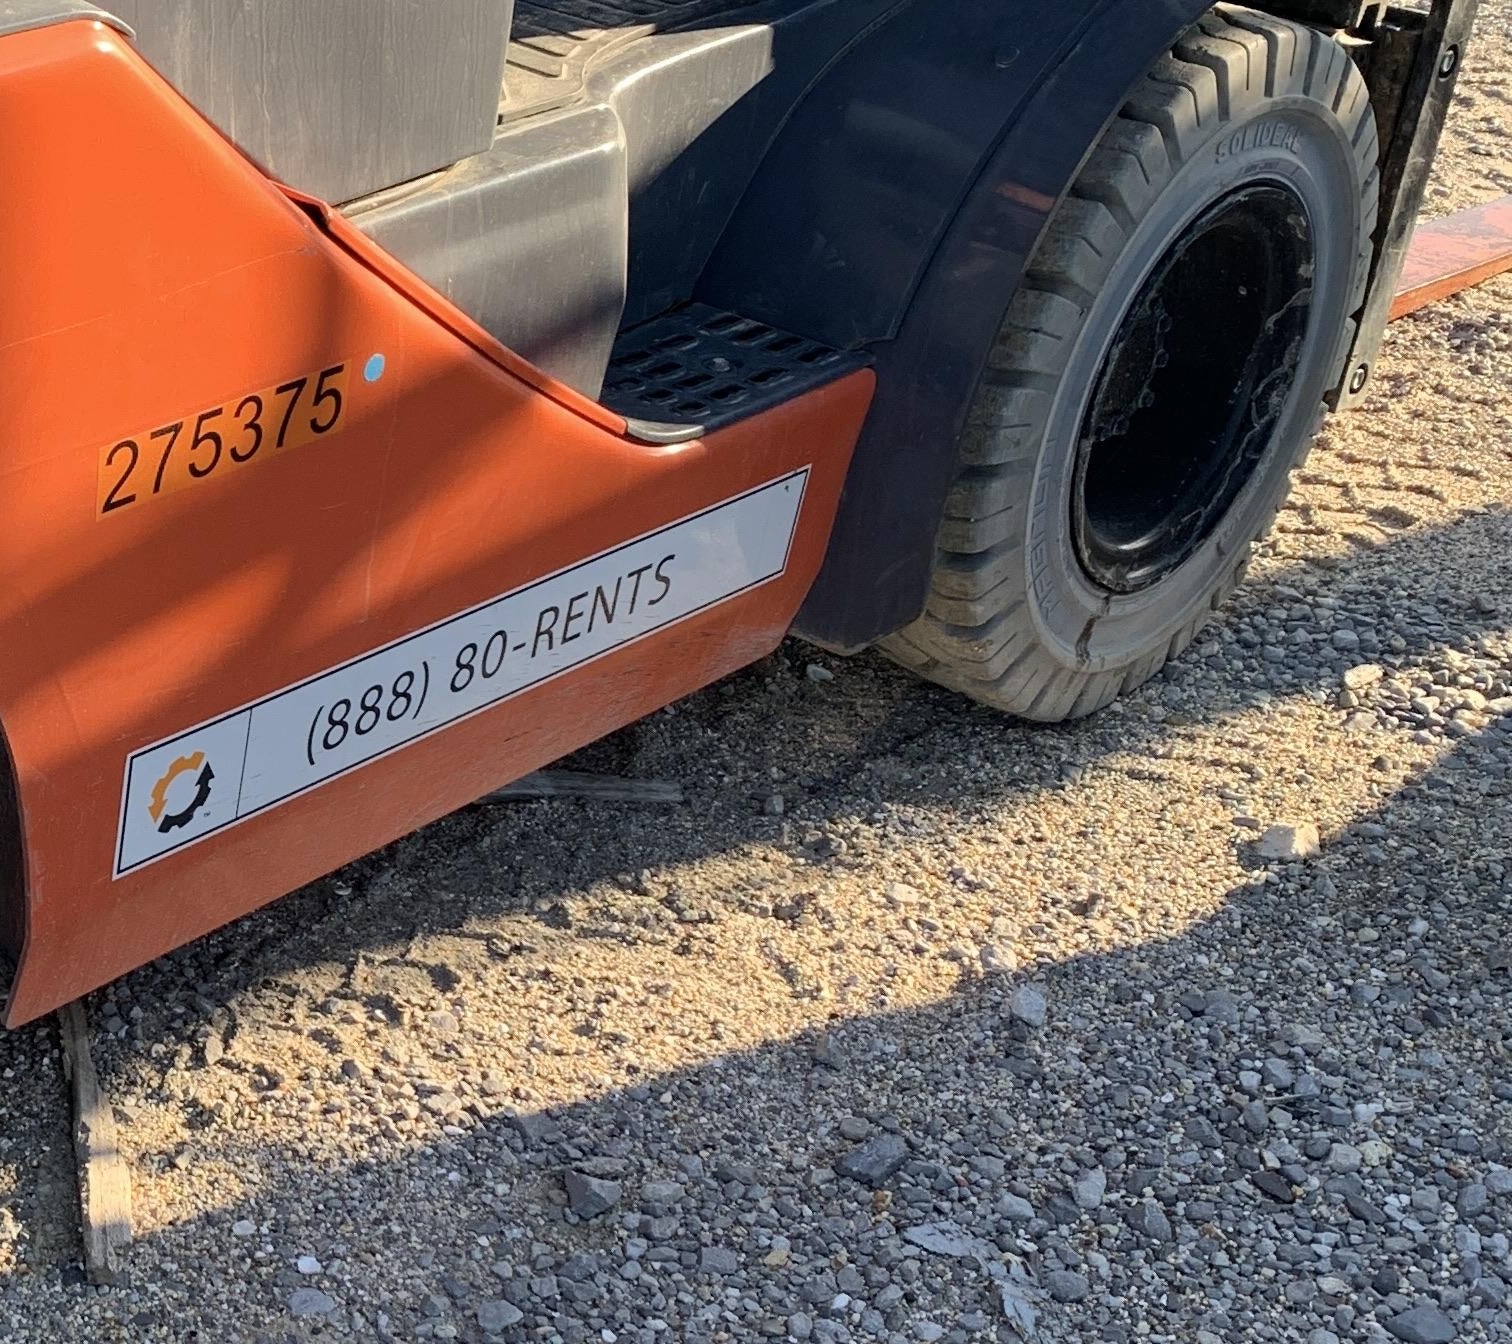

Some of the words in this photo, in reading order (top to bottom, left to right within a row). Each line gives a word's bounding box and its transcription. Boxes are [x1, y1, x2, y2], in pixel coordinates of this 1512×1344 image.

[1214, 121, 1301, 164] SOLIDEAL
[99, 362, 347, 514] 275375
[307, 659, 431, 766] (888)
[450, 553, 675, 694] 80-RENTS
